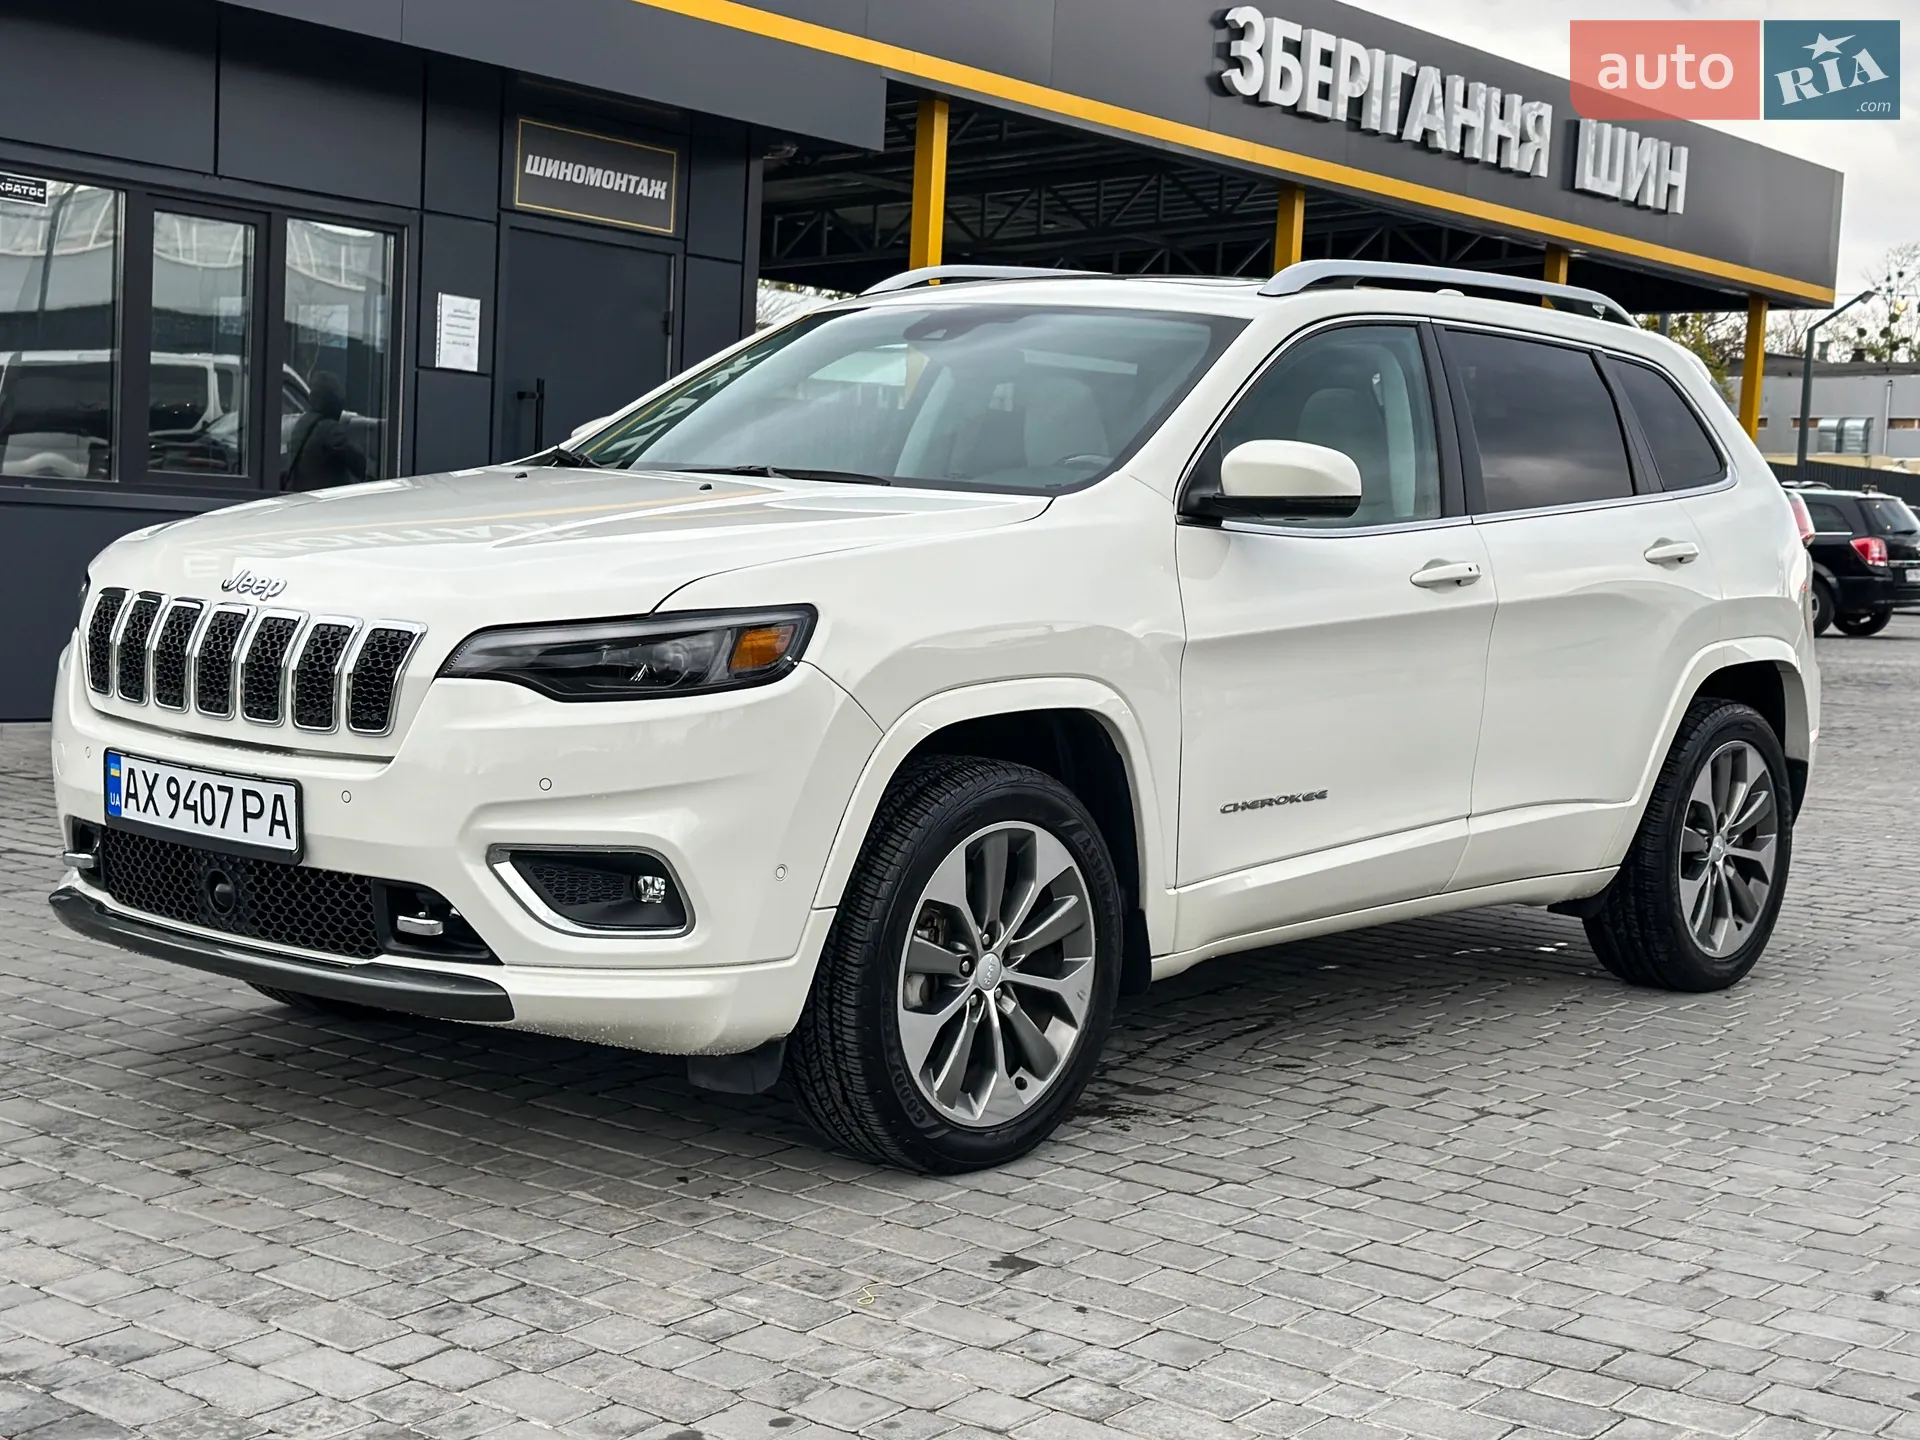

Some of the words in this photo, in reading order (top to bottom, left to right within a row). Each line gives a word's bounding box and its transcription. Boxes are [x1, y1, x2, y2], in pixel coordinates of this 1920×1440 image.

[1221, 6, 1552, 178] ЗБЕРІГАННЯ
[1574, 117, 1689, 215] ШИН
[524, 154, 668, 200] ШИНОМОНТАЖ
[221, 569, 287, 600] Jeep
[110, 792, 121, 807] UA
[166, 776, 234, 829] 9407
[1219, 789, 1329, 815] CHEROKEE
